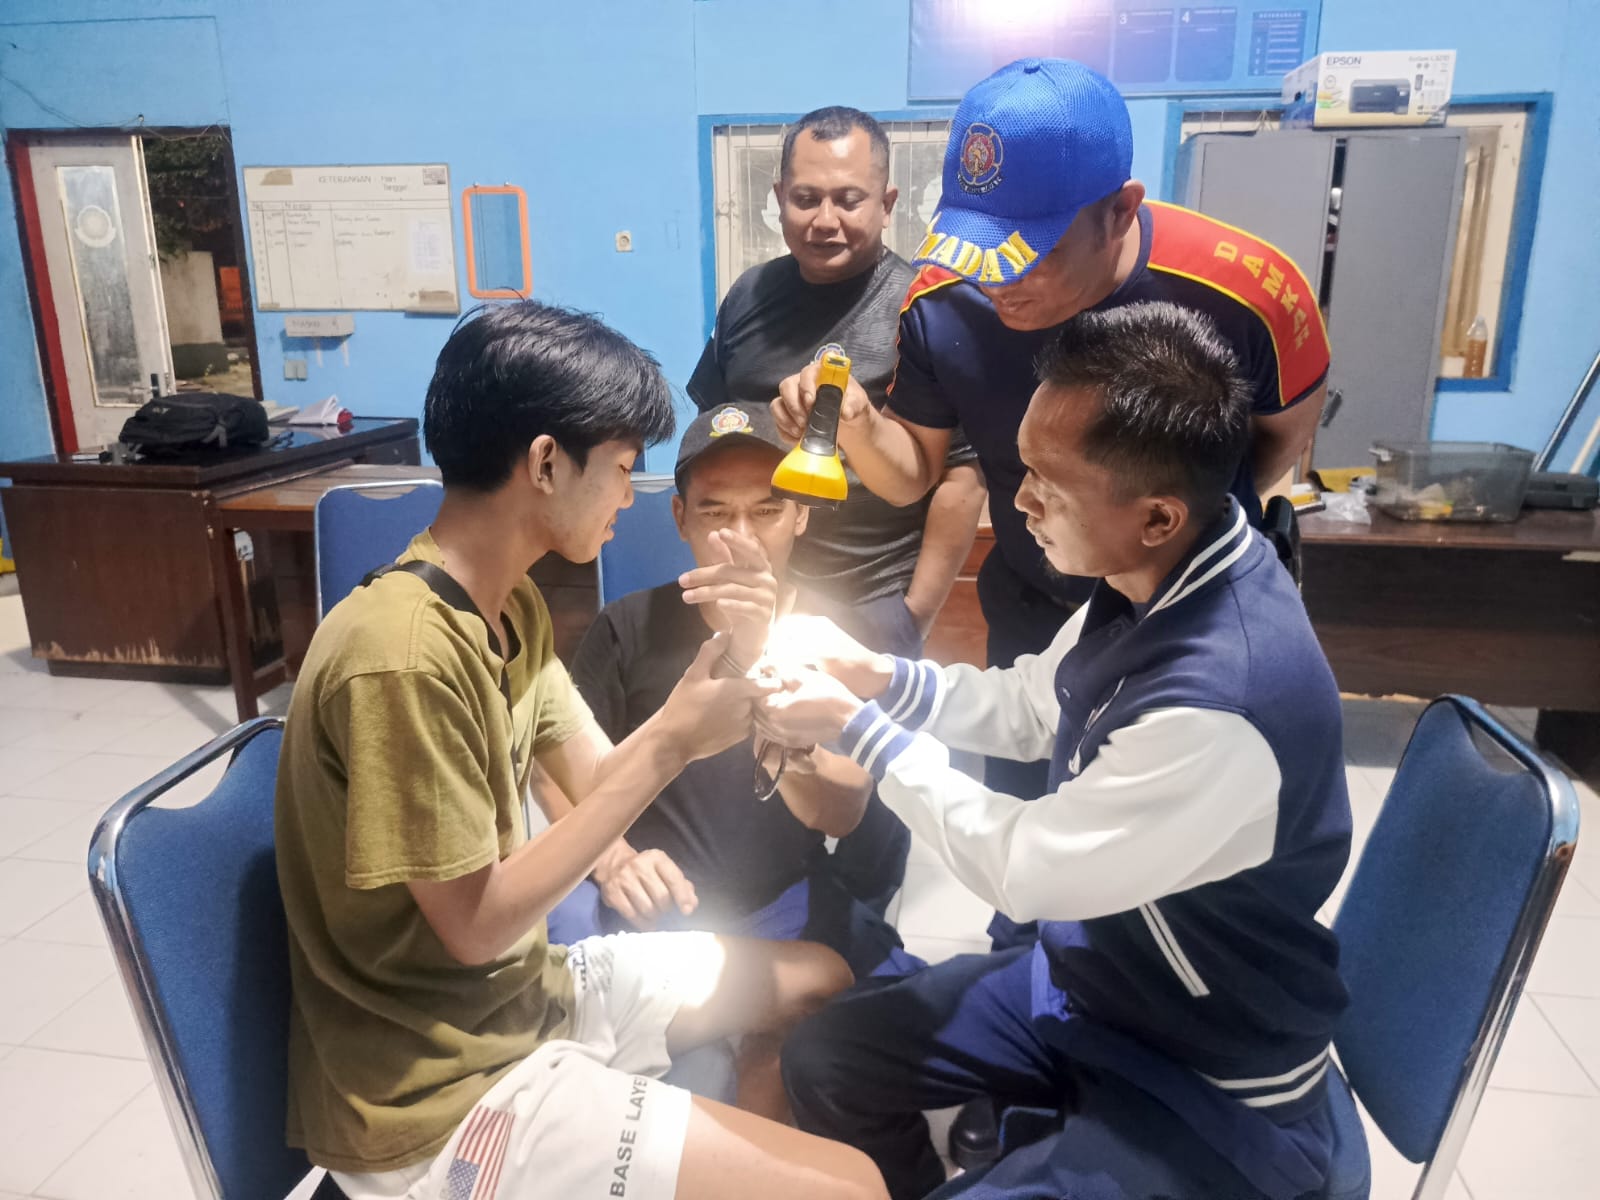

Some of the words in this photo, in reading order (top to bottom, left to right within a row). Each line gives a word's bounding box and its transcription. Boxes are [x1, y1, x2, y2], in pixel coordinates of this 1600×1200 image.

[1119, 13, 1128, 25] 3
[1181, 11, 1191, 24] 4
[1326, 56, 1362, 66] EPSON
[1213, 240, 1310, 352] DAMKAR
[609, 1129, 637, 1198] BASE
[625, 1077, 648, 1122] LAYE
